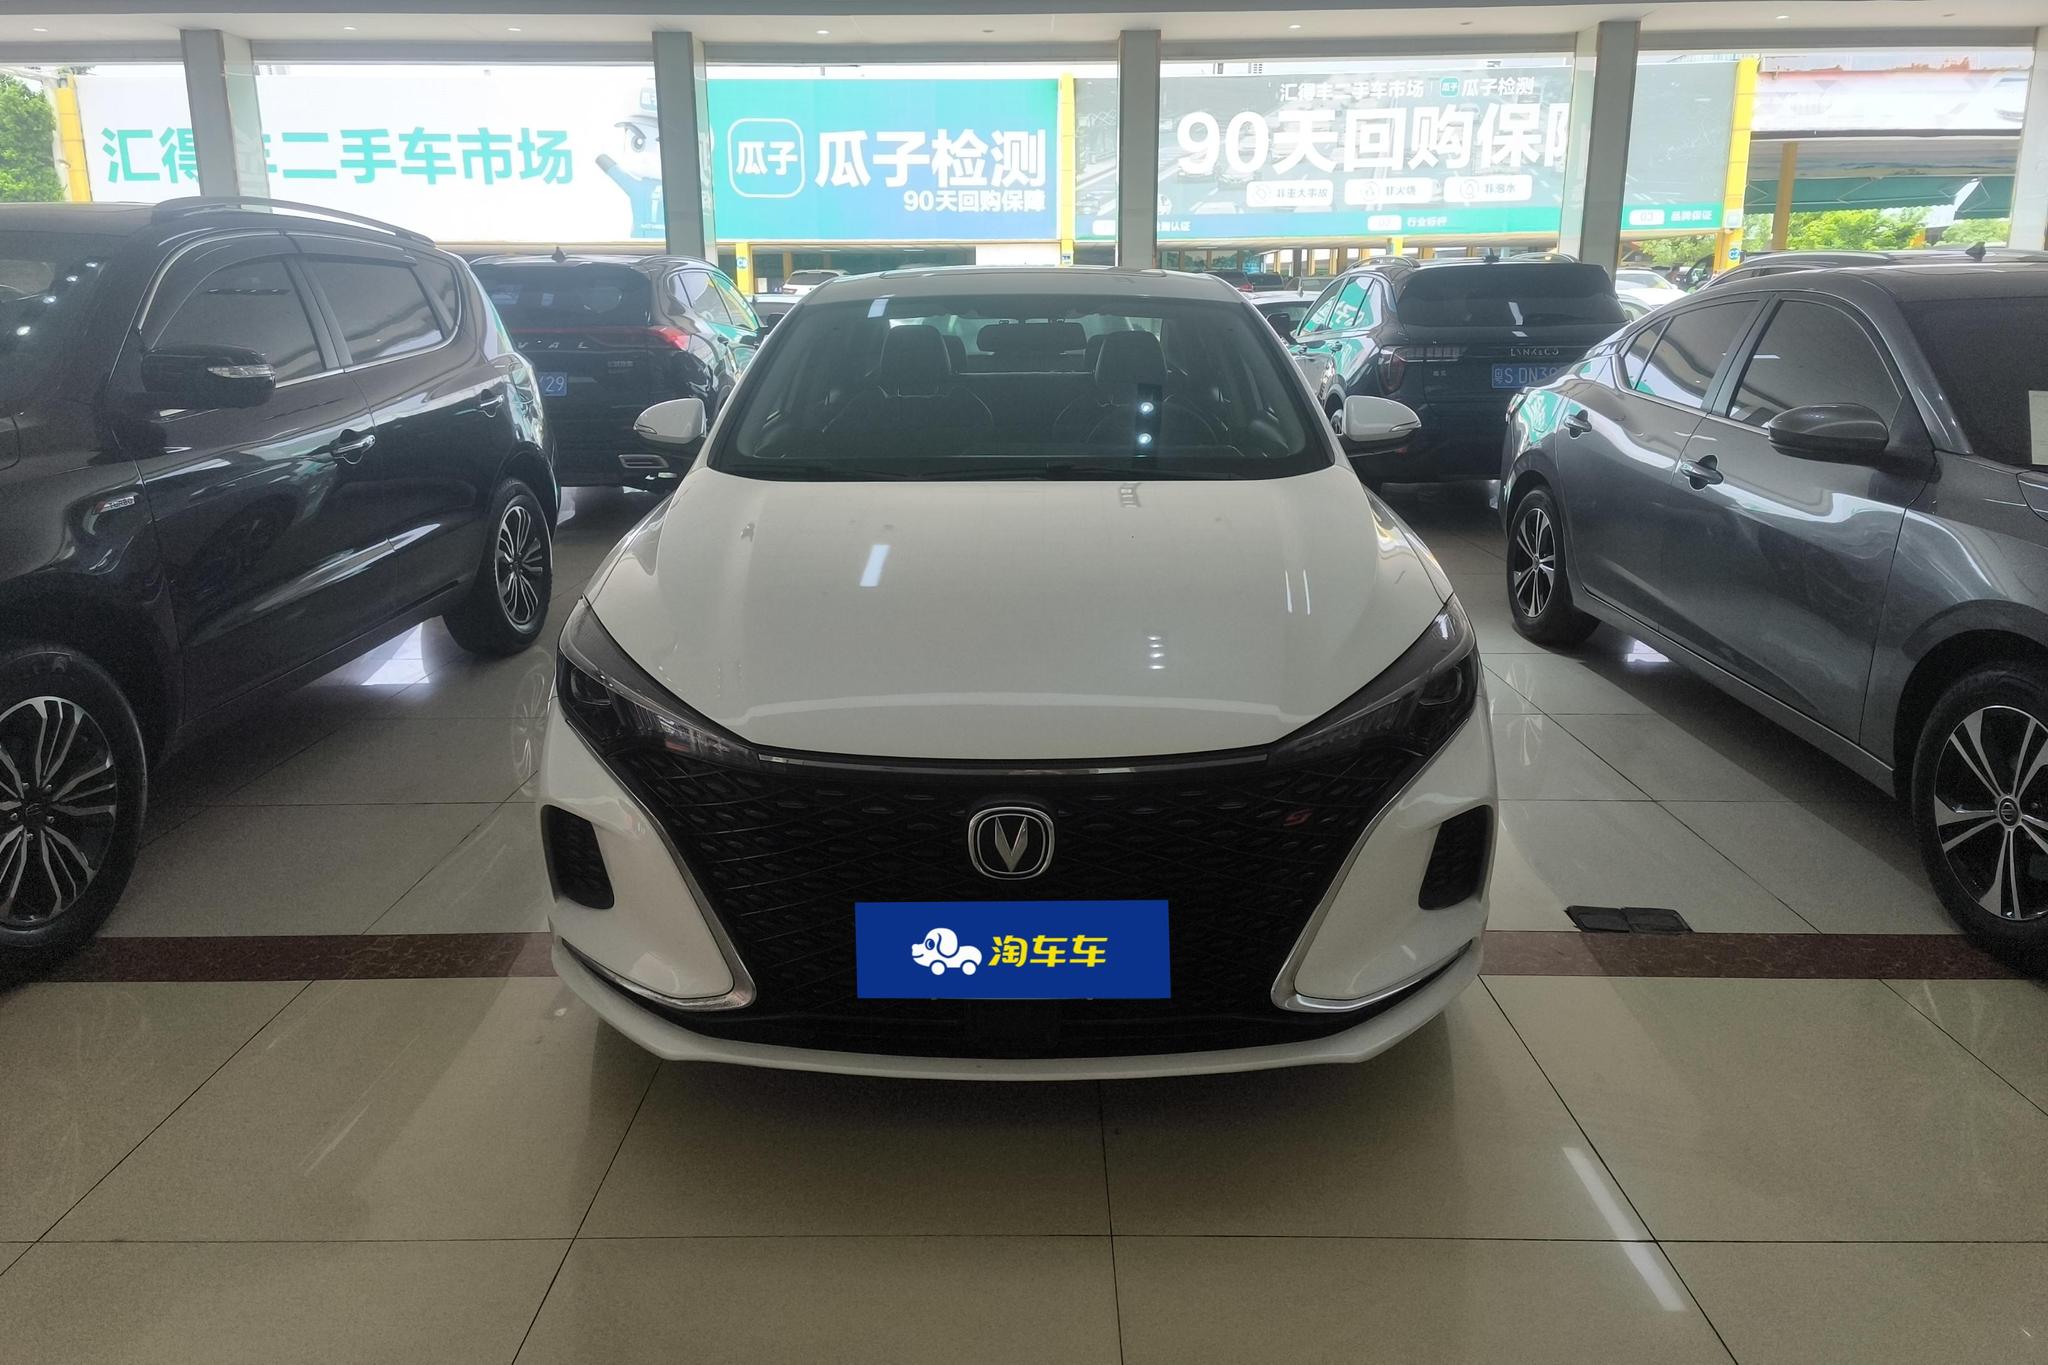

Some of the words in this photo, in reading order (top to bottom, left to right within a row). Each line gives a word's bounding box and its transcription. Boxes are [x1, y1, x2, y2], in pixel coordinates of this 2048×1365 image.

[1462, 77, 1535, 97] 瓜子检测
[101, 127, 573, 185] 汇得二手车市场
[736, 140, 798, 176] 瓜子
[815, 129, 1046, 188] 瓜子检测
[903, 190, 1046, 212] 90天回购保障
[539, 375, 565, 392] 29
